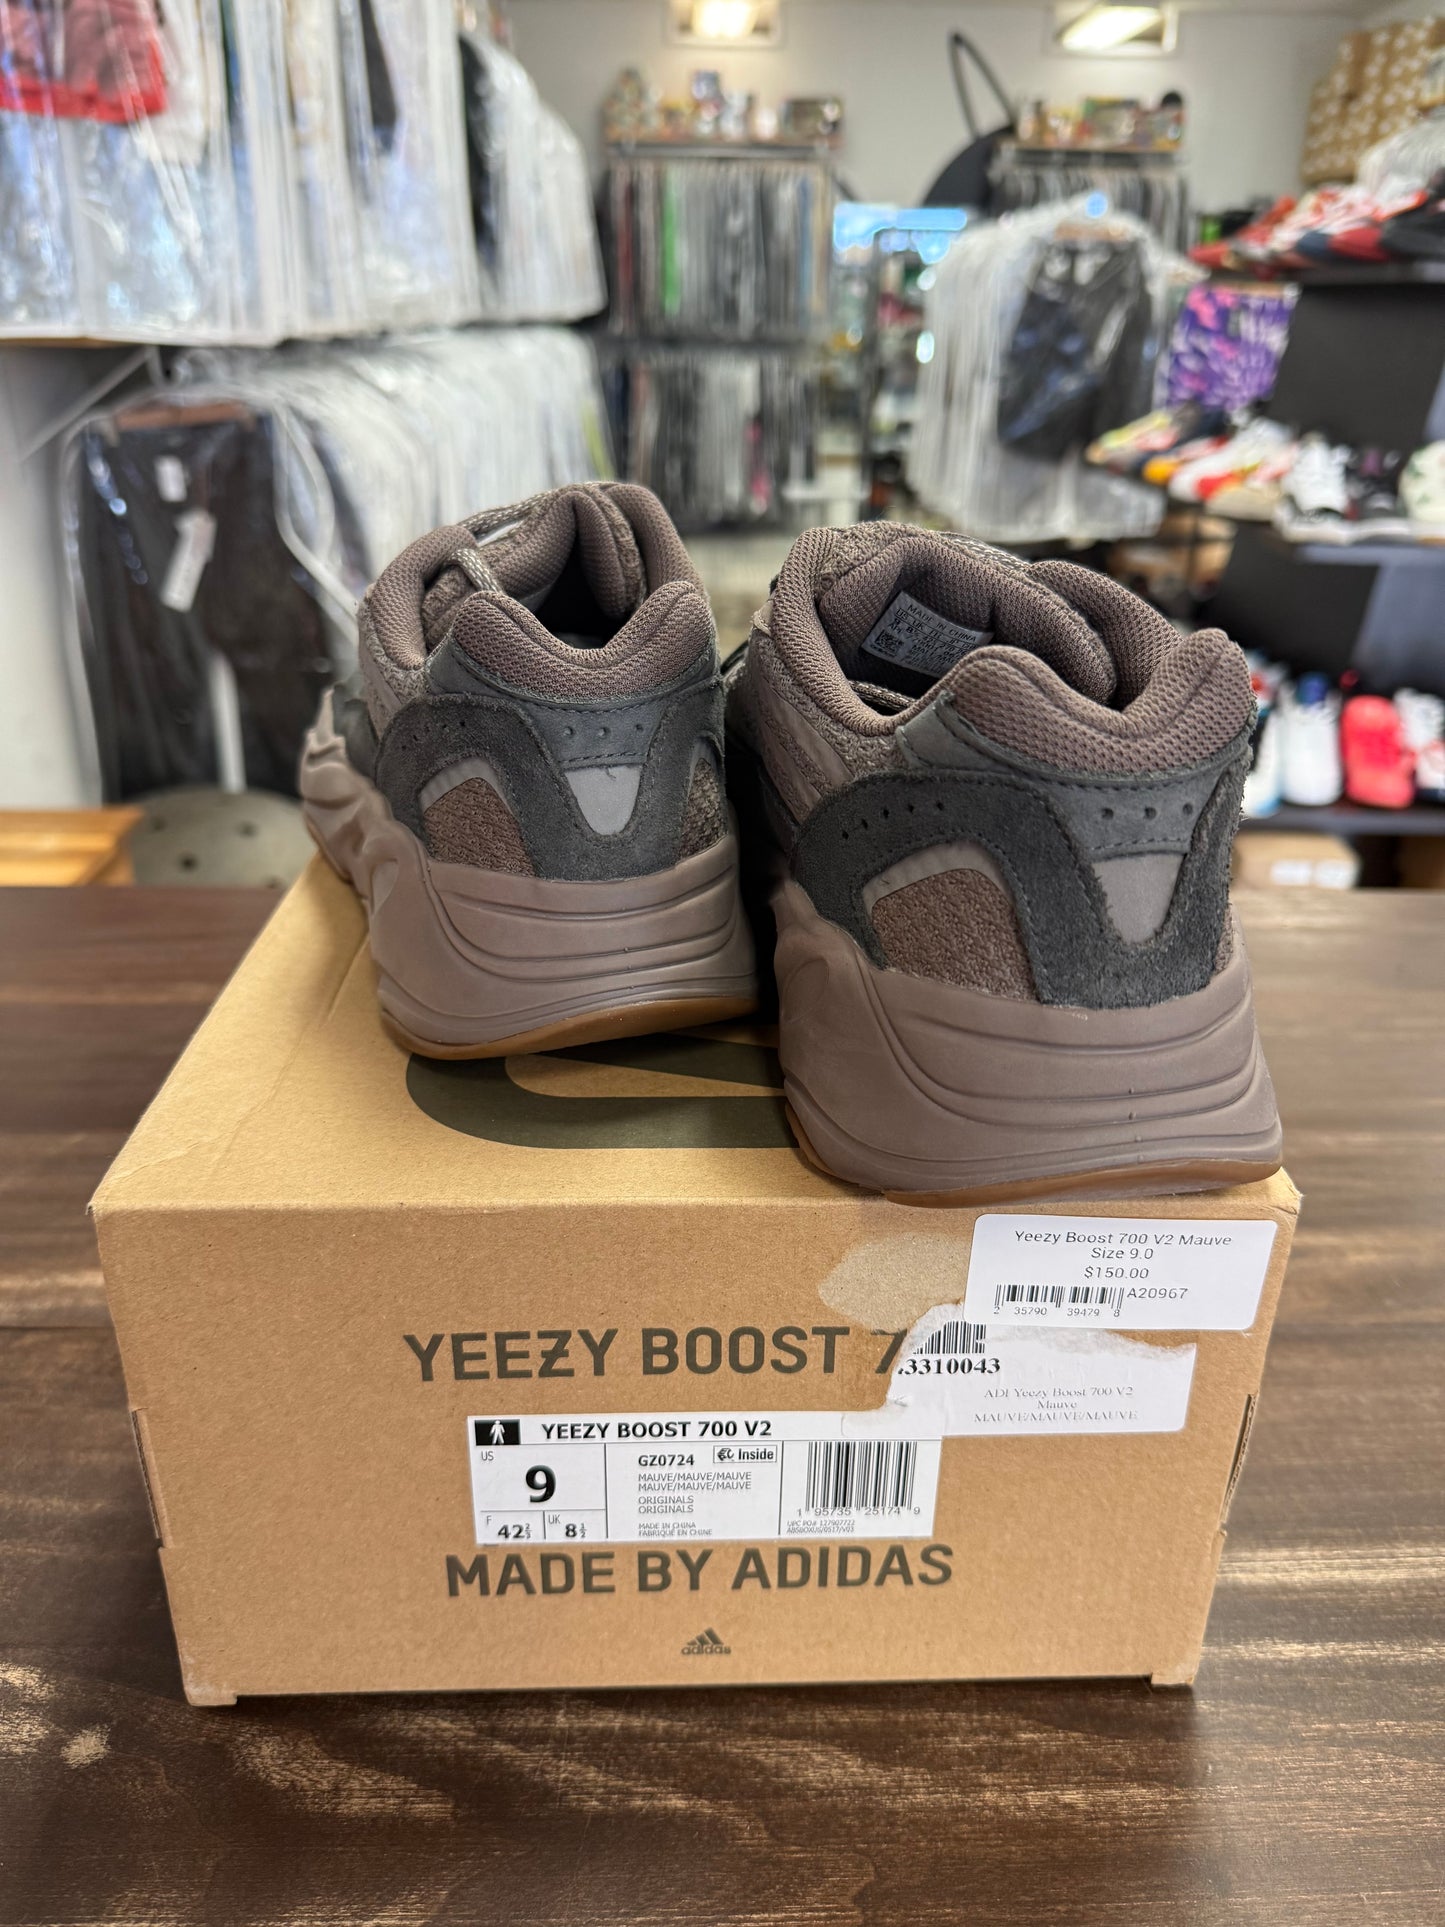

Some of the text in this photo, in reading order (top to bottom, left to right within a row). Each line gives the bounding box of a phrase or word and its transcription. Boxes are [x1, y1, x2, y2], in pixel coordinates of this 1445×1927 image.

[949, 629, 977, 642] CHINA
[1015, 1230, 1232, 1246] Yeezy Boost 700 V2 Mauve
[1091, 1247, 1154, 1260] Size 9.0
[1084, 1265, 1150, 1280] $150.00
[1127, 1287, 1188, 1299] A20967
[1014, 1307, 1048, 1316] 35790
[1067, 1308, 1101, 1317] 39479
[403, 1328, 618, 1382] YEEZY
[641, 1326, 850, 1376] BOOST
[898, 1358, 1000, 1375] 3310043
[984, 1386, 1134, 1399] ADI Yeezy Boost 700 V2
[1037, 1400, 1077, 1410] Mauve
[974, 1411, 1138, 1423] MAUVE/MAUVE/MAUVE
[542, 1420, 772, 1439] YEEZY BOOST 700 V2
[481, 1450, 494, 1461] US
[738, 1448, 774, 1460] Inside
[638, 1454, 695, 1467] GZ0724
[638, 1471, 752, 1483] MAUVE/MAUVE/MAUVE
[525, 1464, 556, 1503] 9
[638, 1481, 752, 1492] MAUVE/MAUVE/MAUVE
[638, 1495, 694, 1505] ORIGINALS
[638, 1504, 694, 1514] ORIGINALS
[814, 1507, 852, 1516] 95735
[864, 1506, 901, 1516] 25174
[913, 1506, 920, 1515] 9
[486, 1515, 492, 1525] F
[548, 1514, 560, 1525] UK
[639, 1522, 659, 1530] MADE
[672, 1521, 696, 1529] CHINA
[677, 1529, 687, 1537] EN
[689, 1528, 713, 1536] CHINE
[446, 1543, 954, 1598] MADE BY ADIDAS
[681, 1643, 731, 1655] adidas
